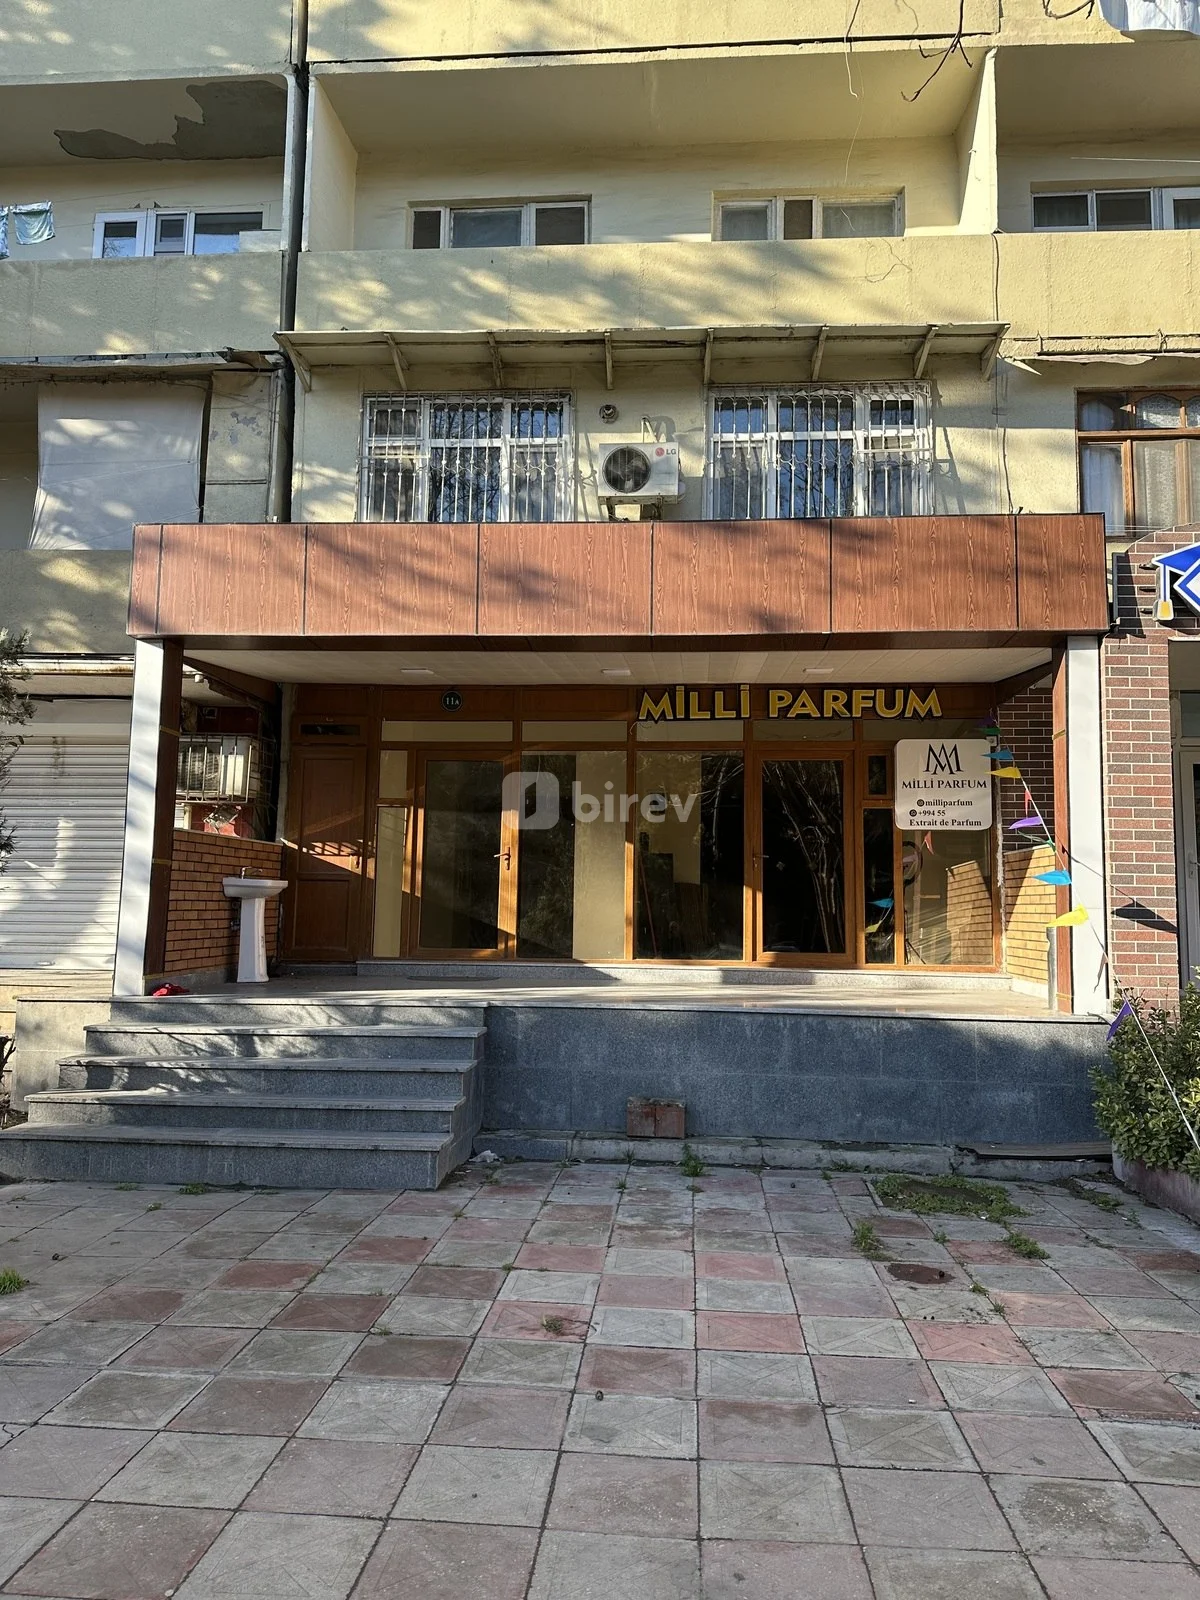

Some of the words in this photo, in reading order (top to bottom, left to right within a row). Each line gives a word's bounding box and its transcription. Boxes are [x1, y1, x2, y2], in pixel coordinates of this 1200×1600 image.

[446, 697, 460, 706] 11A
[637, 684, 750, 721] MİLLİ
[767, 687, 943, 719] PARFUM
[901, 778, 934, 789] MİLLİ
[937, 779, 988, 789] PARFUM
[925, 799, 973, 807] milliparfum
[918, 809, 936, 817] +994
[937, 809, 946, 817] 55
[909, 819, 938, 827] Extrait
[939, 819, 950, 827] de
[951, 819, 982, 827] Parfum
